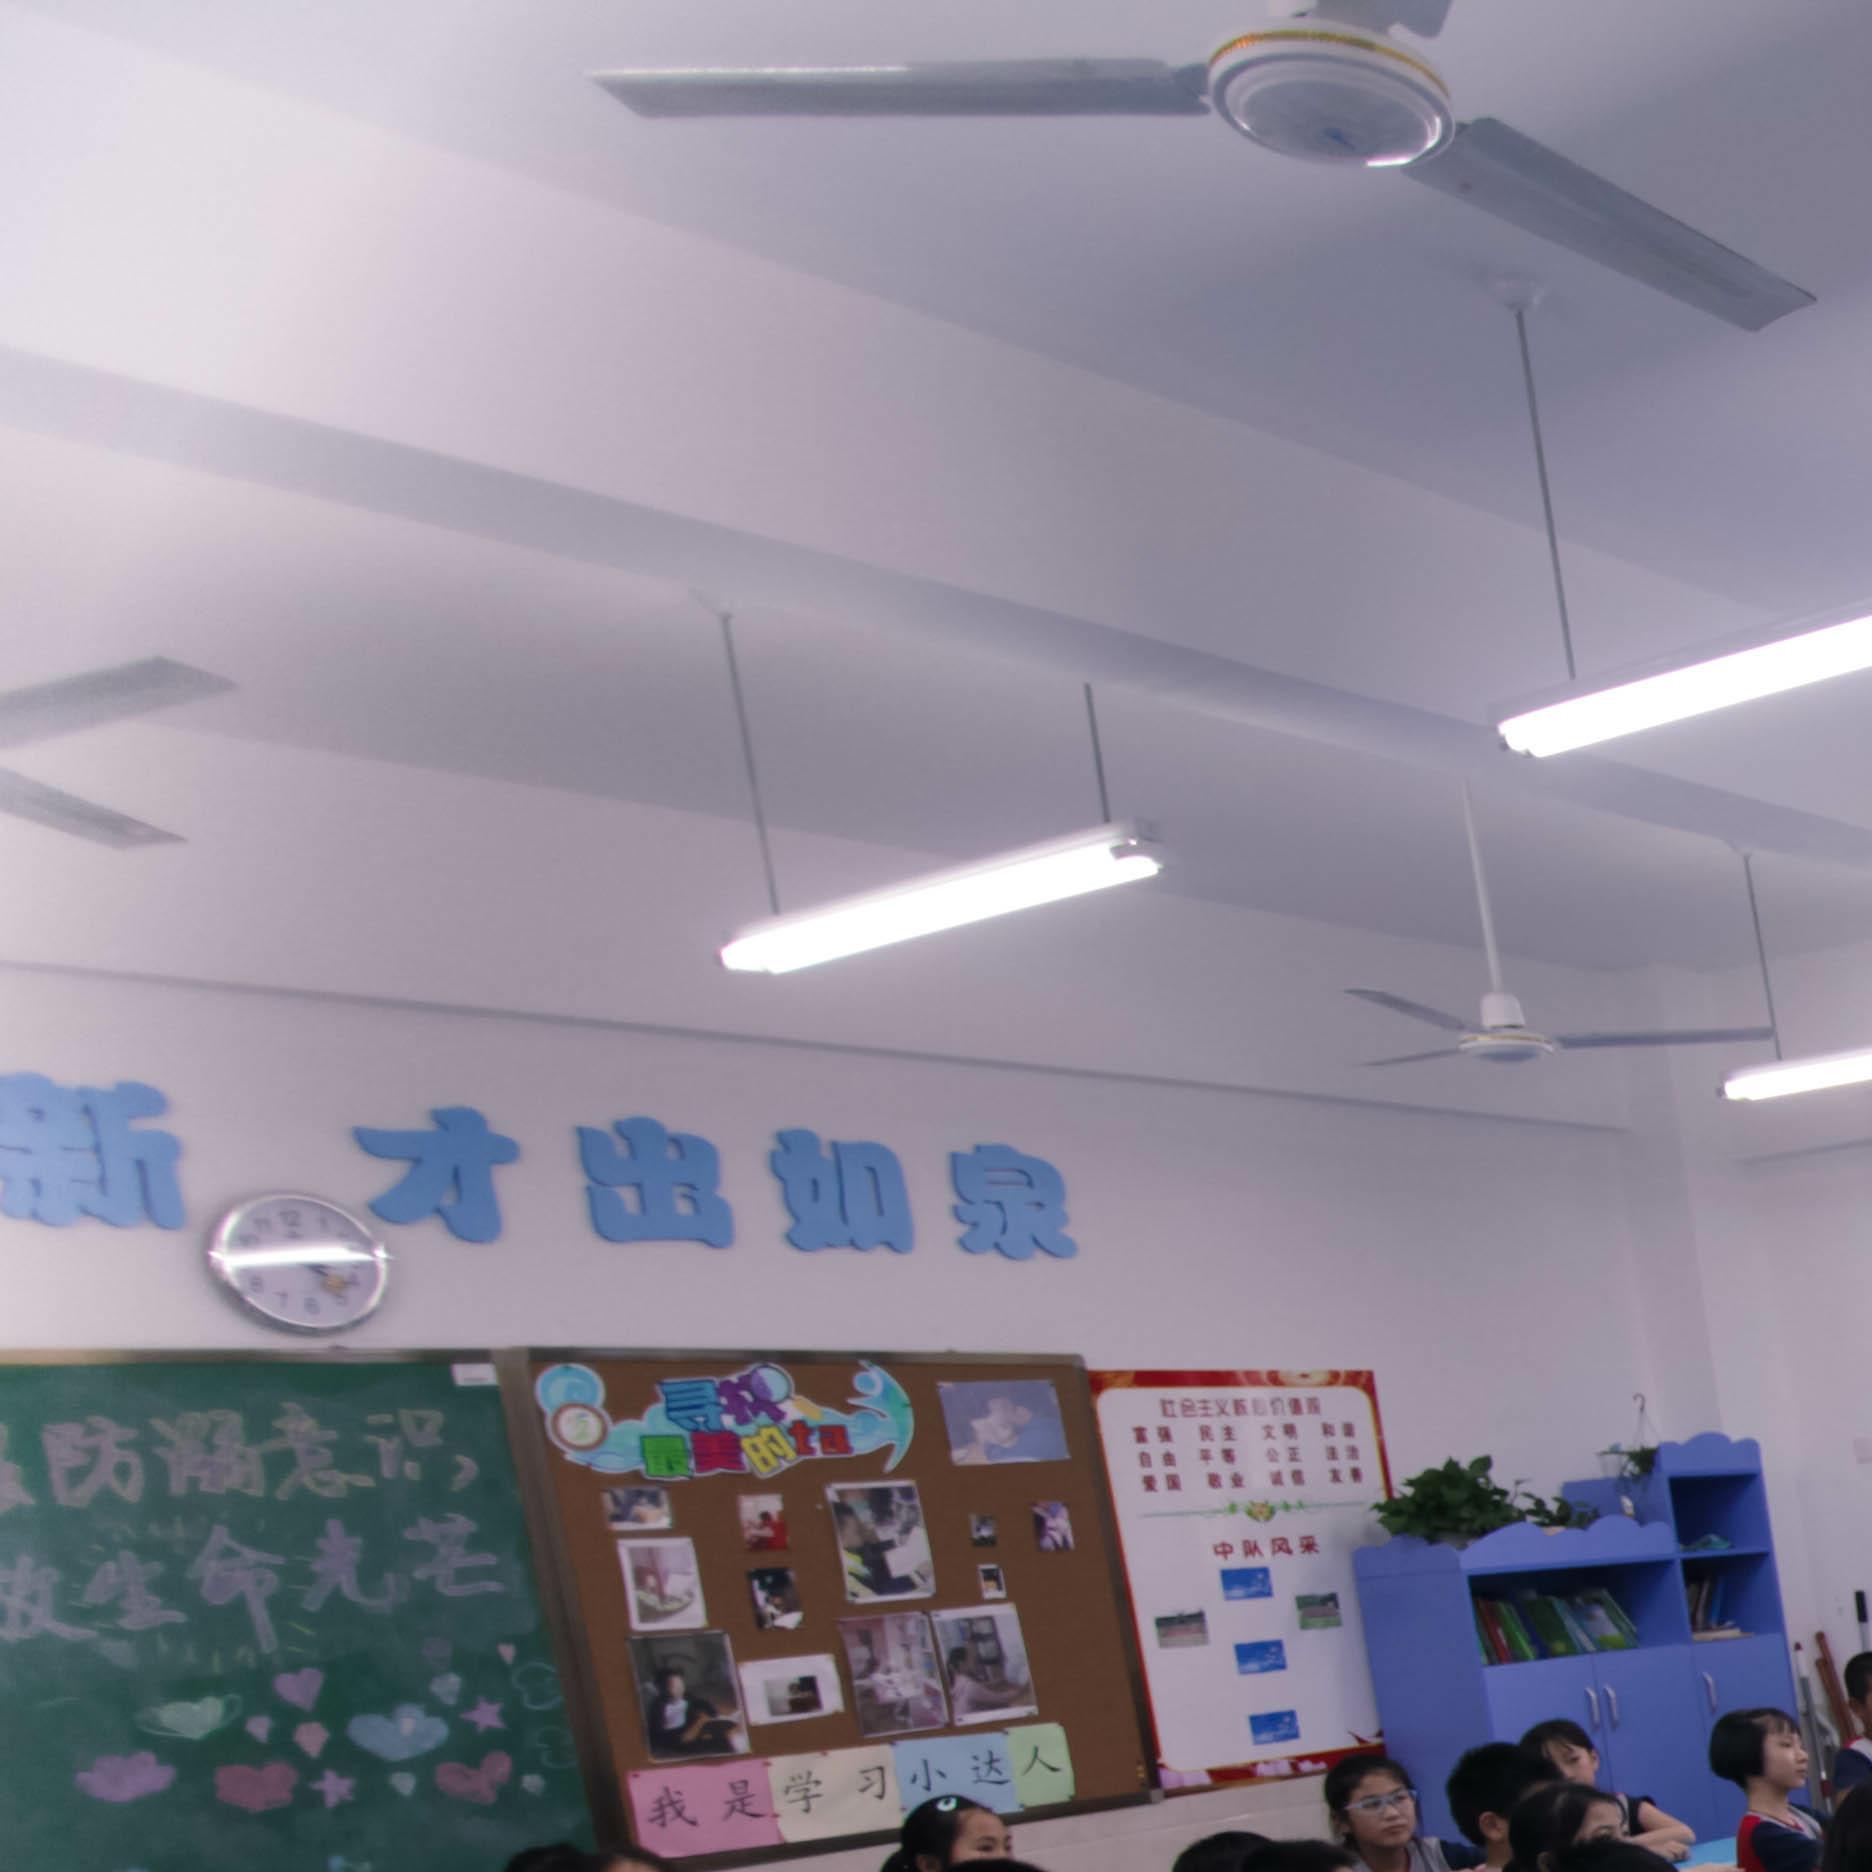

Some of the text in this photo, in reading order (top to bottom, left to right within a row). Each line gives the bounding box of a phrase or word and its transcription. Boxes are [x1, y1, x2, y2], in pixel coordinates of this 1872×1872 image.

[1212, 1535, 1320, 1560] 中队风采
[647, 1745, 1062, 1830] 我是学习小达人
